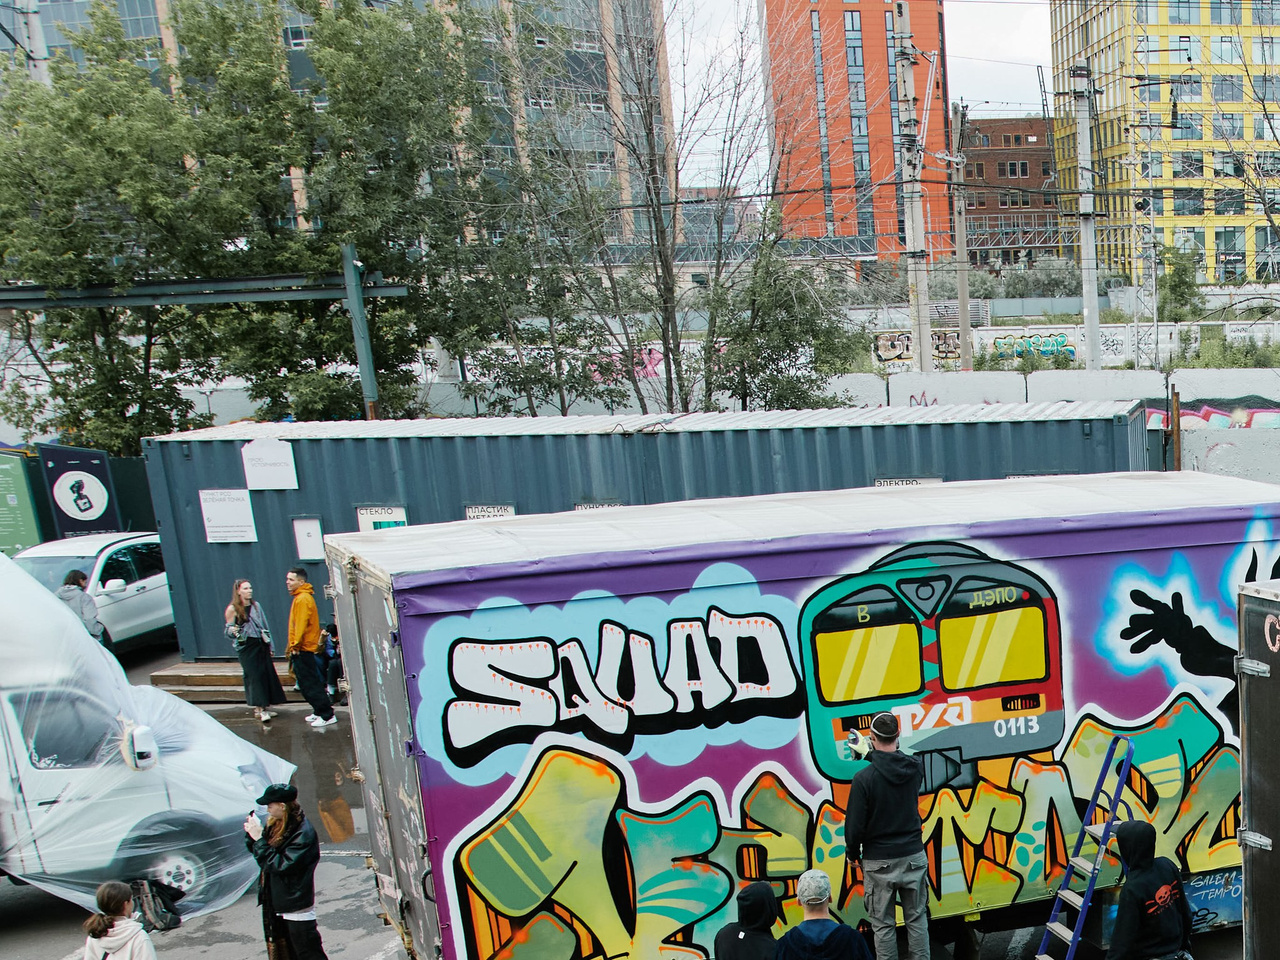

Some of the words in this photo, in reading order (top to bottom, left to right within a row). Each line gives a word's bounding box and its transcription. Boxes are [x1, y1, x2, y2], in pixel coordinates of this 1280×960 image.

[359, 507, 394, 515] СТЕКЛО
[467, 506, 509, 514] ПЛАСТИК
[968, 586, 1017, 609] ДЭПО
[443, 606, 806, 768] SQUAD
[993, 715, 1040, 738] 0113
[1192, 885, 1242, 900] TEMPO
